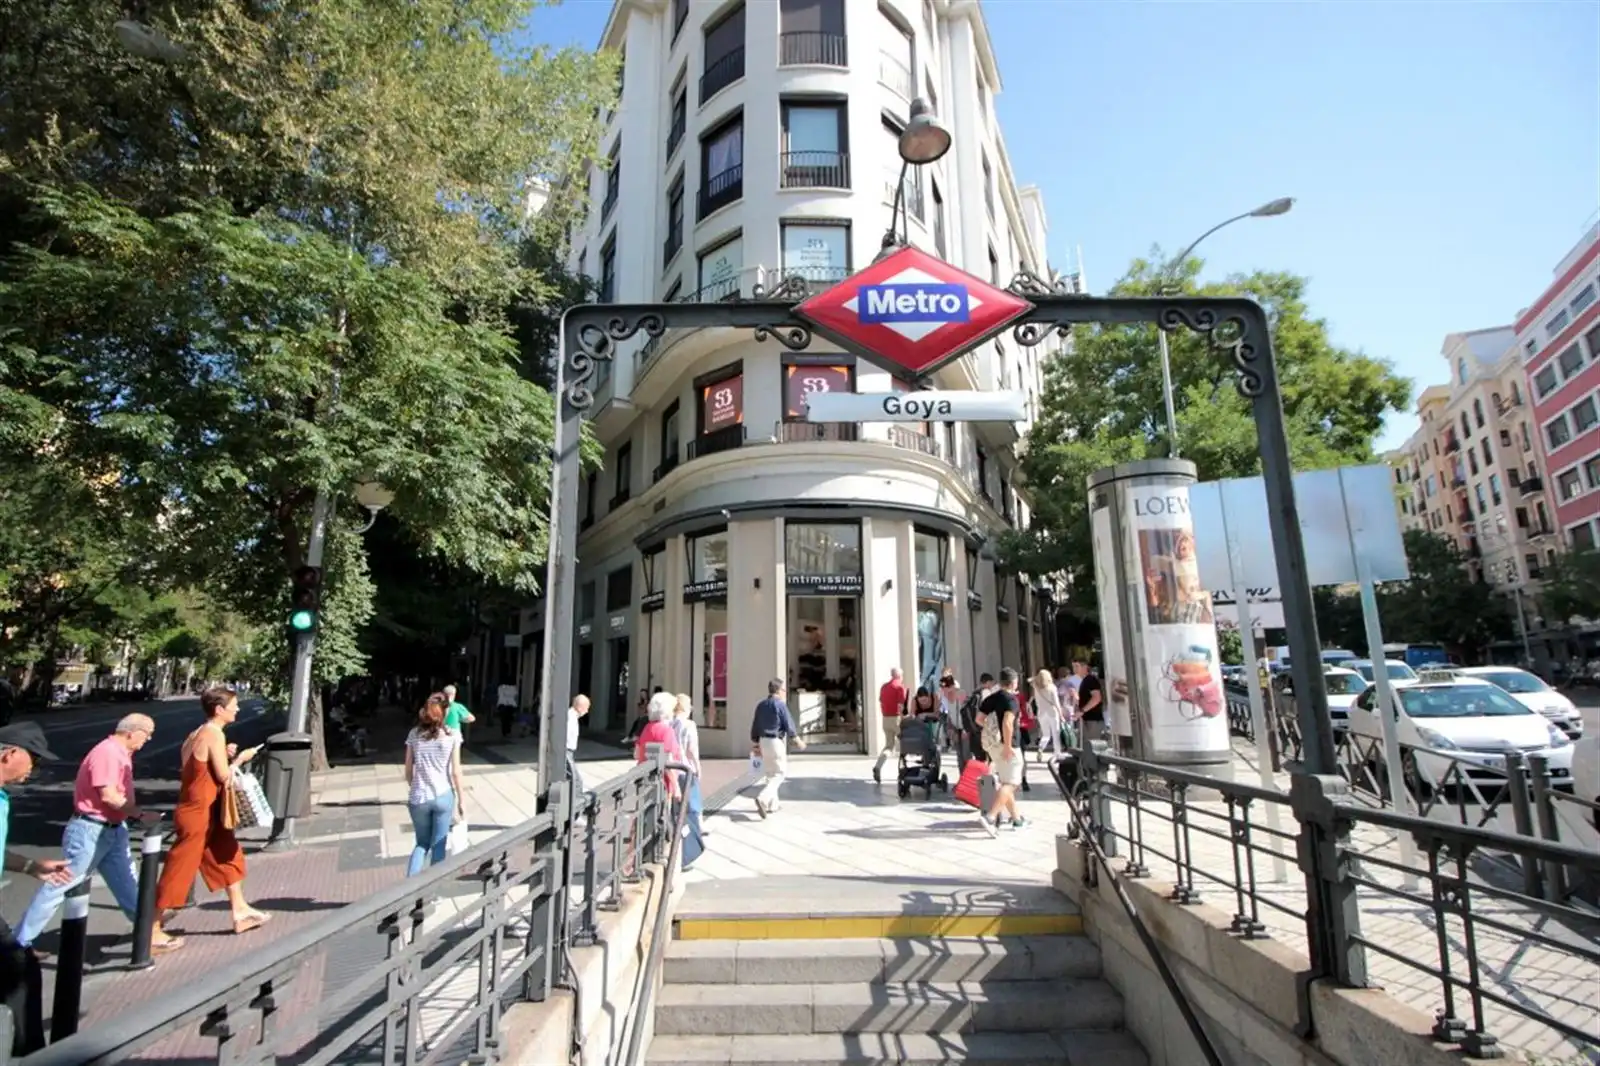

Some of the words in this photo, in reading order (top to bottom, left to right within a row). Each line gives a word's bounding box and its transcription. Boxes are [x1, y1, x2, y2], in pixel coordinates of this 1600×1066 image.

[867, 289, 961, 314] Metro
[883, 396, 952, 418] Goya
[788, 575, 862, 584] intimissimi
